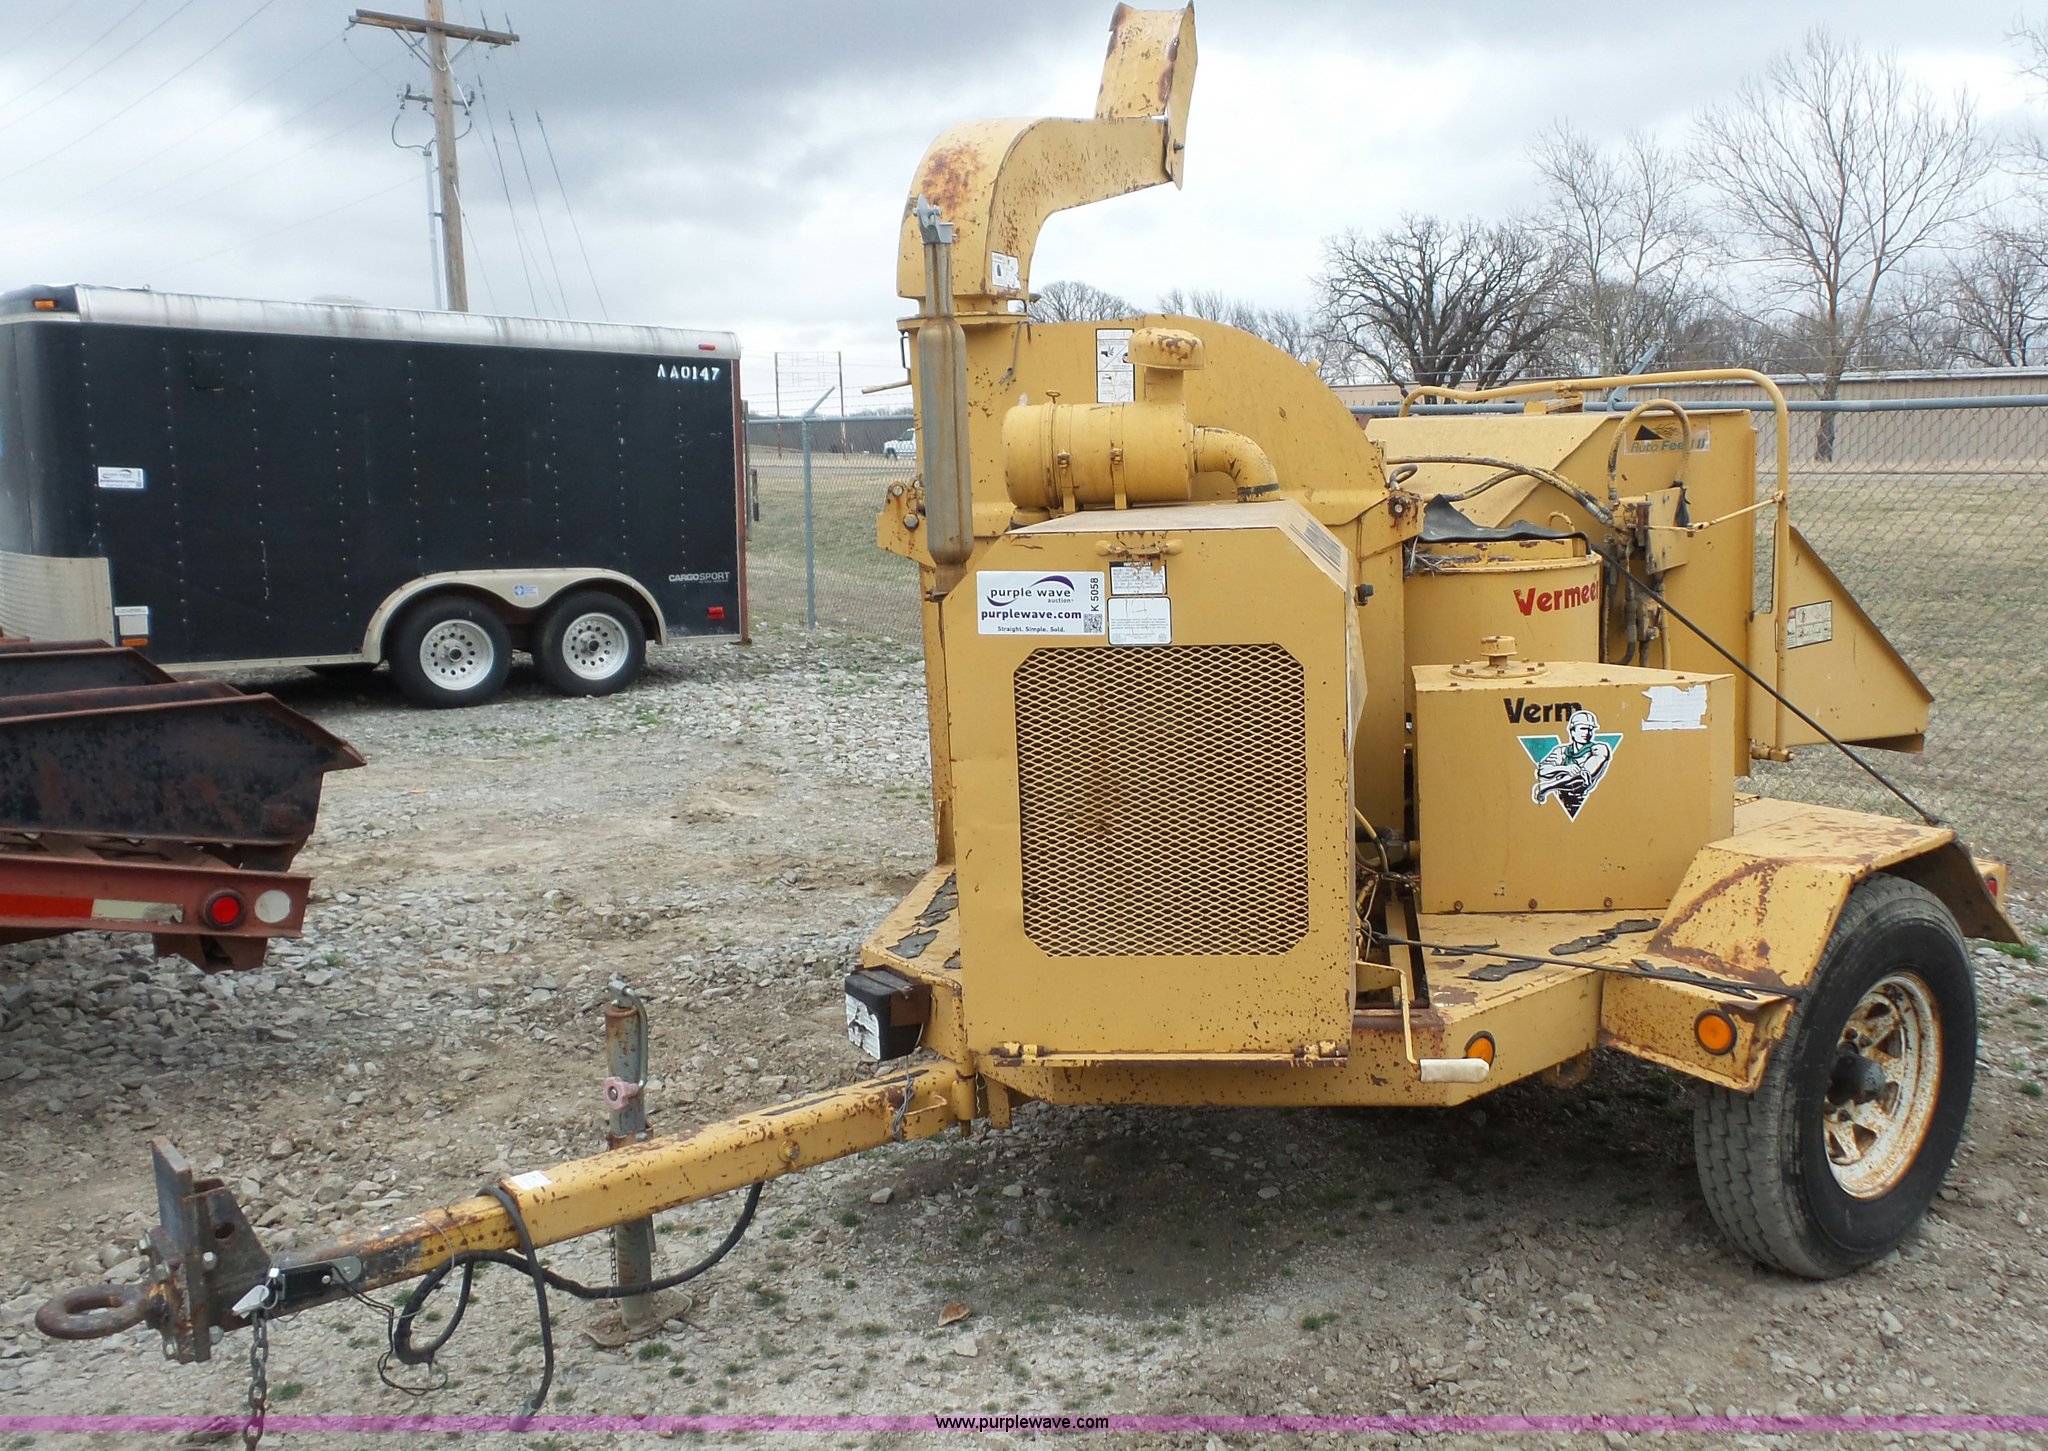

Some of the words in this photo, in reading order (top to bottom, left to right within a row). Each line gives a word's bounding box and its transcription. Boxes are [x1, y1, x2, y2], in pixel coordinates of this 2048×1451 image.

[1631, 442, 1658, 453] Auto
[990, 587, 1032, 598] purple
[1037, 589, 1071, 597] wave
[1090, 577, 1099, 602] 5058
[1090, 604, 1099, 612] K
[981, 609, 1082, 620] purplewave.com
[997, 625, 1024, 633] Straight.
[1025, 625, 1049, 633] Simple.
